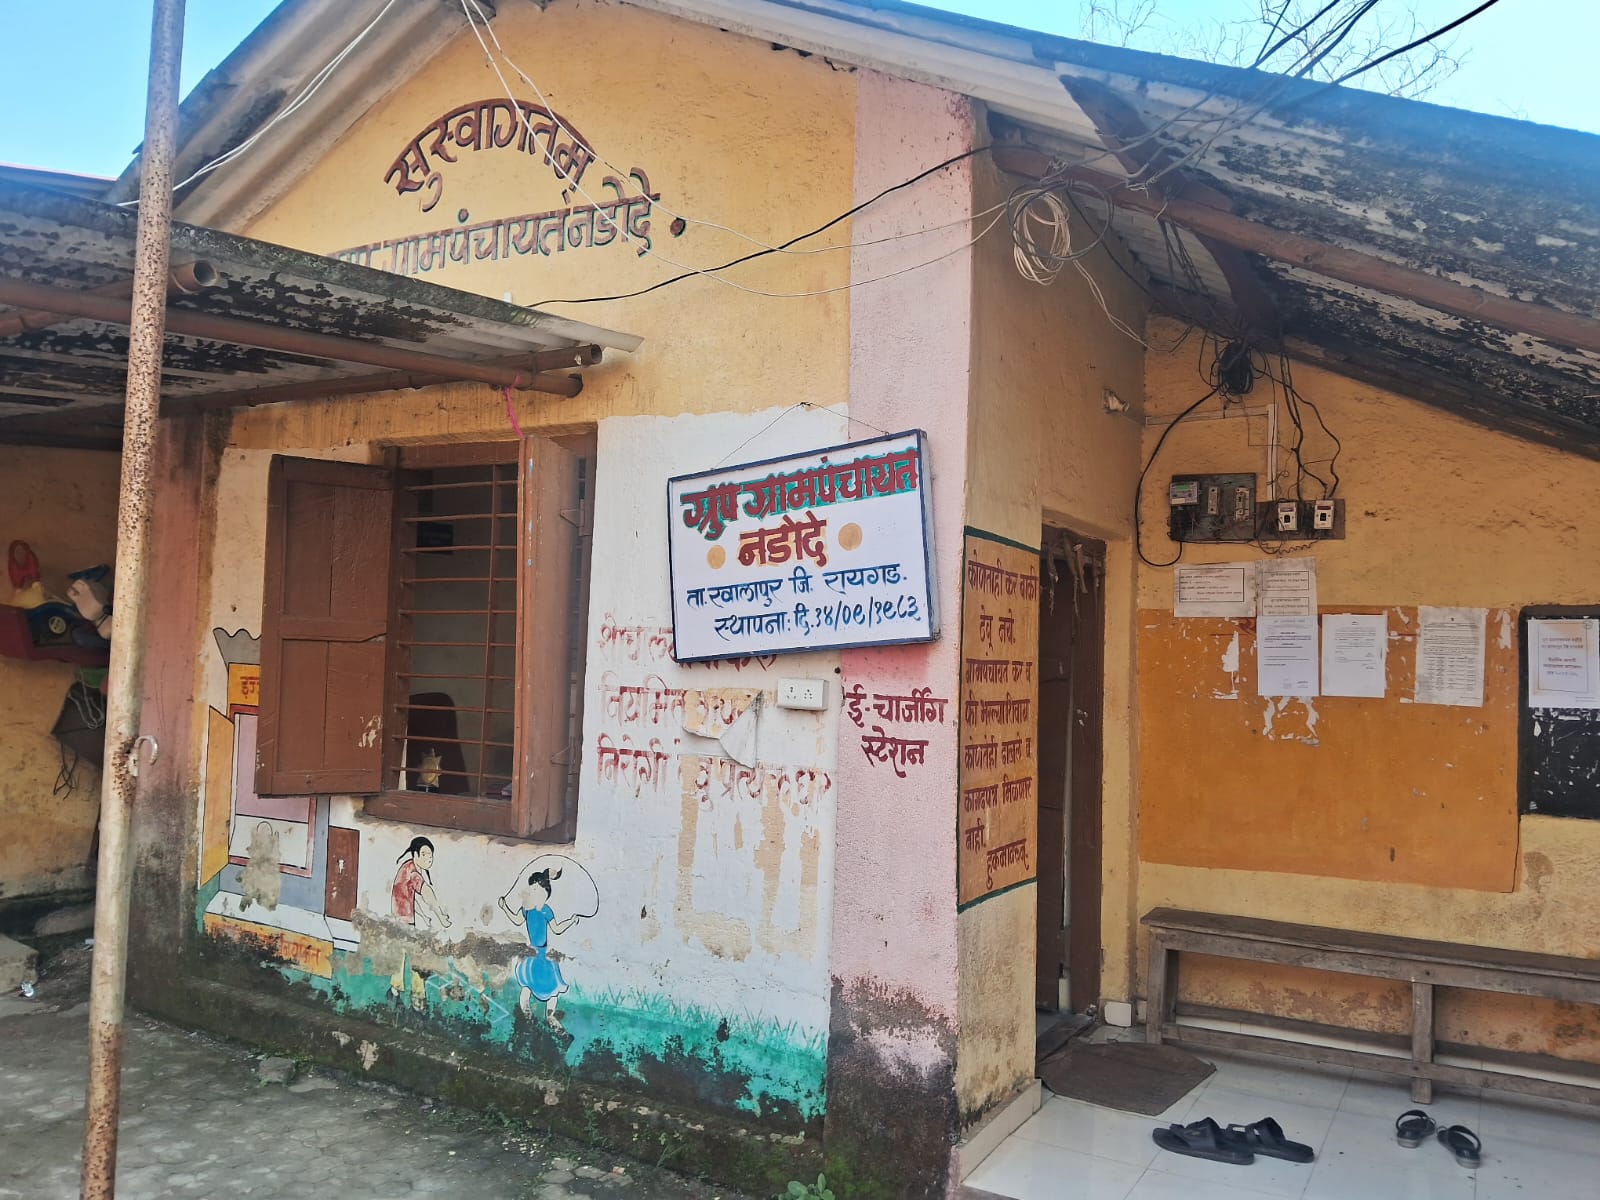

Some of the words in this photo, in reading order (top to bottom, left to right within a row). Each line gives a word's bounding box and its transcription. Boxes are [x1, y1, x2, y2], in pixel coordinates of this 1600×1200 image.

[742, 446, 919, 521] ग्रामपंचायत
[738, 510, 827, 567] नडोदे
[789, 565, 813, 595] जि.
[1005, 570, 1018, 600] कर
[1011, 659, 1023, 683] कर
[860, 725, 929, 778] स्टेशन
